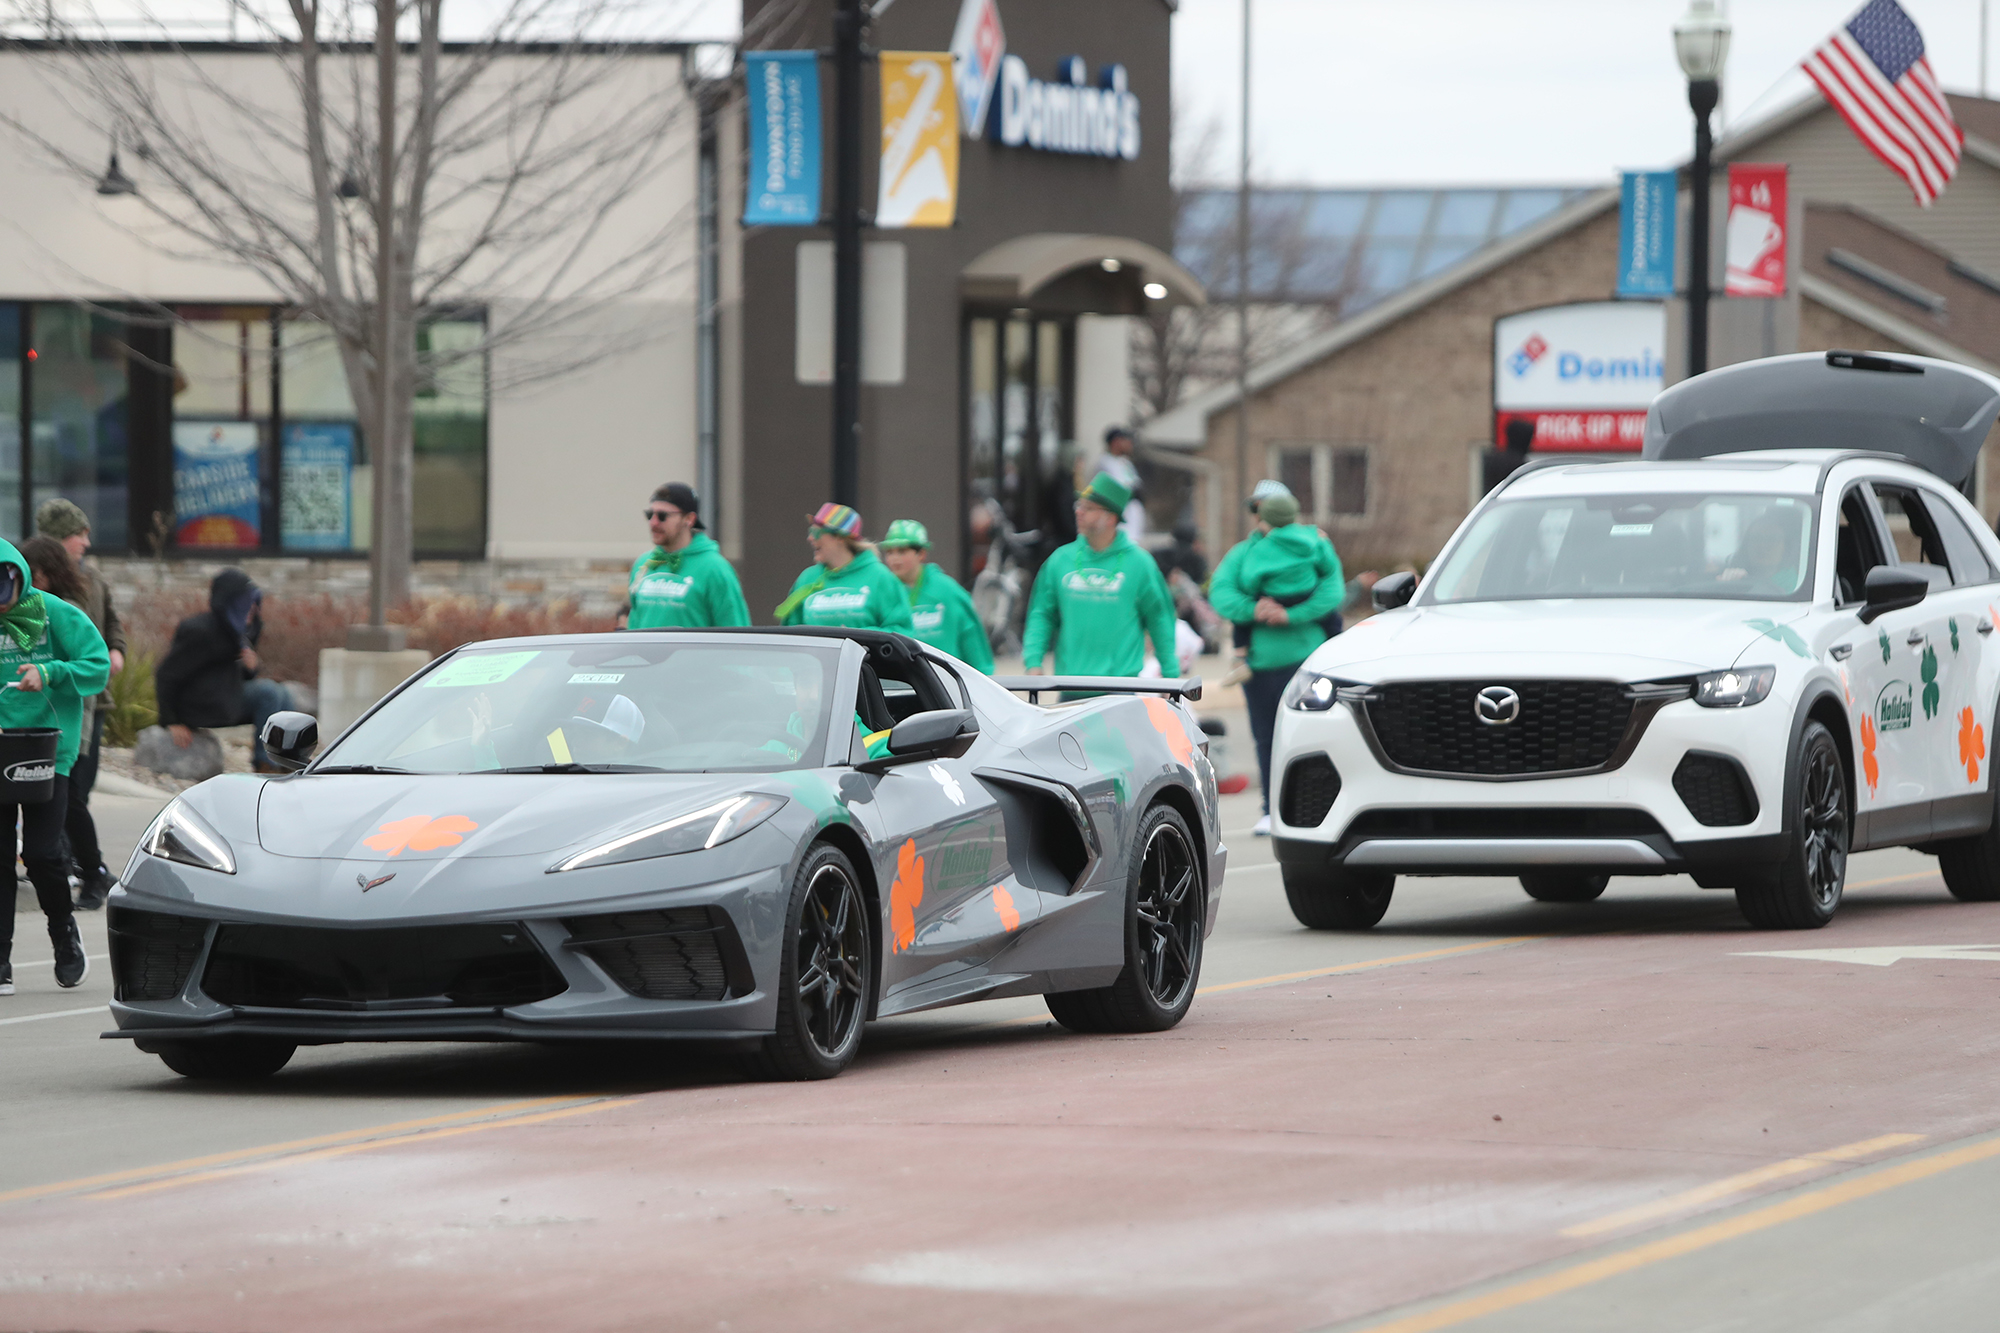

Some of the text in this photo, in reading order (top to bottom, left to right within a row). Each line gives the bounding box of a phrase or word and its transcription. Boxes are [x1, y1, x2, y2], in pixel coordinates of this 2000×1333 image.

[1000, 54, 1140, 160] Domino's
[763, 61, 786, 192] DOWNTOWN
[1536, 413, 1615, 443] PICK-UP
[1880, 694, 1912, 728] Holiday
[13, 765, 56, 779] Holida
[940, 840, 993, 877] Holiday
